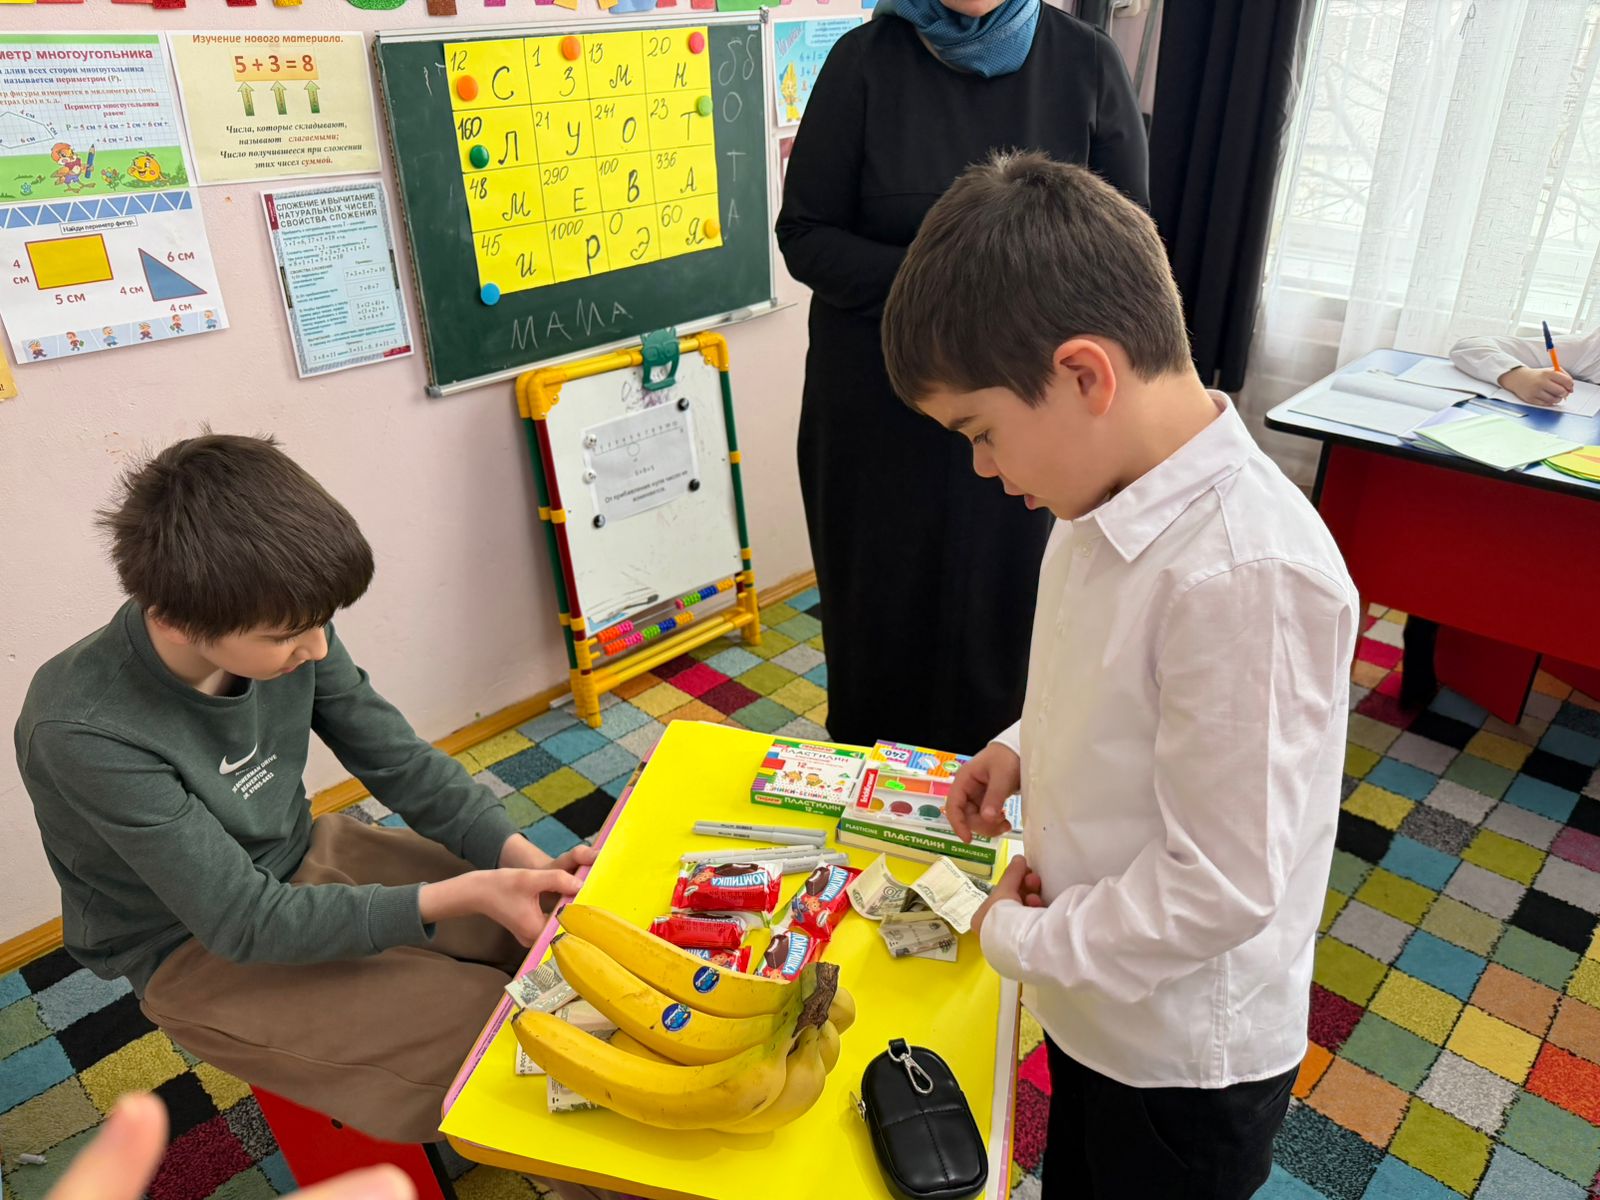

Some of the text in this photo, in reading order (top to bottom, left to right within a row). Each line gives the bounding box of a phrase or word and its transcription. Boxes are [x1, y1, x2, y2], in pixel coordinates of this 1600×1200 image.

[193, 34, 241, 45] Изучение
[283, 35, 344, 44] материала.
[647, 37, 672, 57] 20
[36, 50, 153, 61] многоугольника
[451, 50, 468, 72] 12
[532, 45, 541, 68] 1
[589, 42, 604, 64] 13
[49, 67, 78, 75] сторон
[235, 56, 247, 74] 5
[268, 55, 281, 72] 3
[302, 54, 314, 72] 8
[56, 76, 106, 84] периметром
[492, 66, 514, 101] С
[594, 103, 616, 120] 241
[650, 98, 669, 120] 23
[226, 122, 347, 134] Числа, которые складывают,
[458, 117, 482, 141] 160
[536, 112, 550, 130] 21
[239, 133, 340, 145] называют слагаемыми;
[220, 144, 362, 159] Число получившееся при сложении
[255, 156, 333, 169] этих чисел суммой.
[599, 158, 619, 176] 100
[656, 152, 678, 170] 336
[543, 166, 570, 186] 290
[470, 178, 488, 200] 48
[276, 200, 320, 212] СЛОЖЕНИЕ
[327, 192, 376, 205] ВЫЧИТАНИЕ
[279, 205, 343, 220] НАТУРАЛЬНЫХ
[345, 201, 377, 211] ЧИСЕЛ.
[281, 209, 378, 228] СВОЙСТВА СЛОЖЕНИЯ
[662, 205, 683, 228] 60
[85, 222, 115, 230] периметр
[550, 219, 584, 241] 1000
[481, 234, 503, 257] 45
[13, 259, 21, 269] 4
[167, 252, 195, 262] 6 см
[13, 276, 30, 285] см
[55, 293, 86, 305] 5 см
[120, 286, 144, 295] 4 см
[170, 304, 177, 312] 4
[241, 769, 267, 793] BEAVERTON
[785, 797, 841, 812] ПЛАСТИЛИН
[845, 824, 878, 835] PLASTICINE
[883, 830, 946, 850] ПЛАСТИЛИН
[711, 872, 770, 887] ЛОМТИШКА
[782, 932, 809, 975] ЛОМТИШКА
